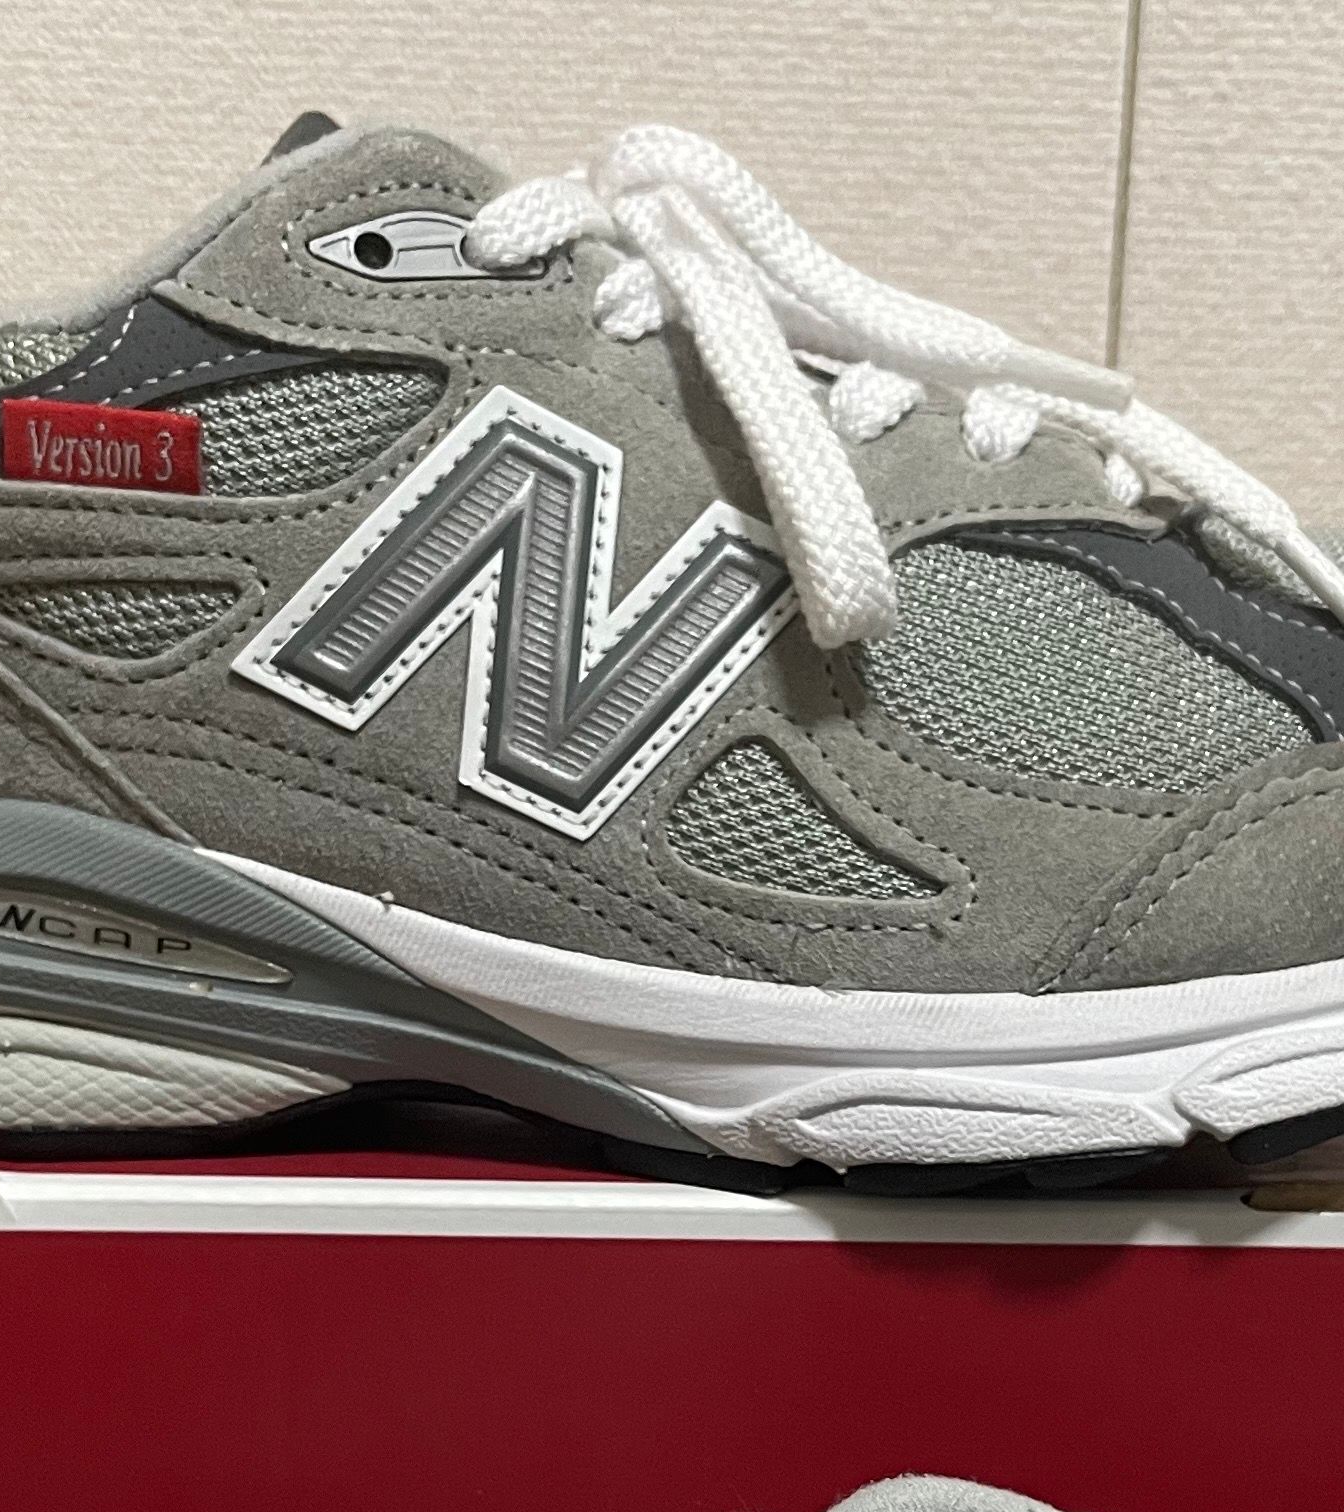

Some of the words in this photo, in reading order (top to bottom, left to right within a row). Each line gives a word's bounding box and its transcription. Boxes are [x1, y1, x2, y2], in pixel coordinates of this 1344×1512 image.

[27, 419, 142, 481] Version
[156, 431, 174, 482] 3
[231, 384, 800, 841] N
